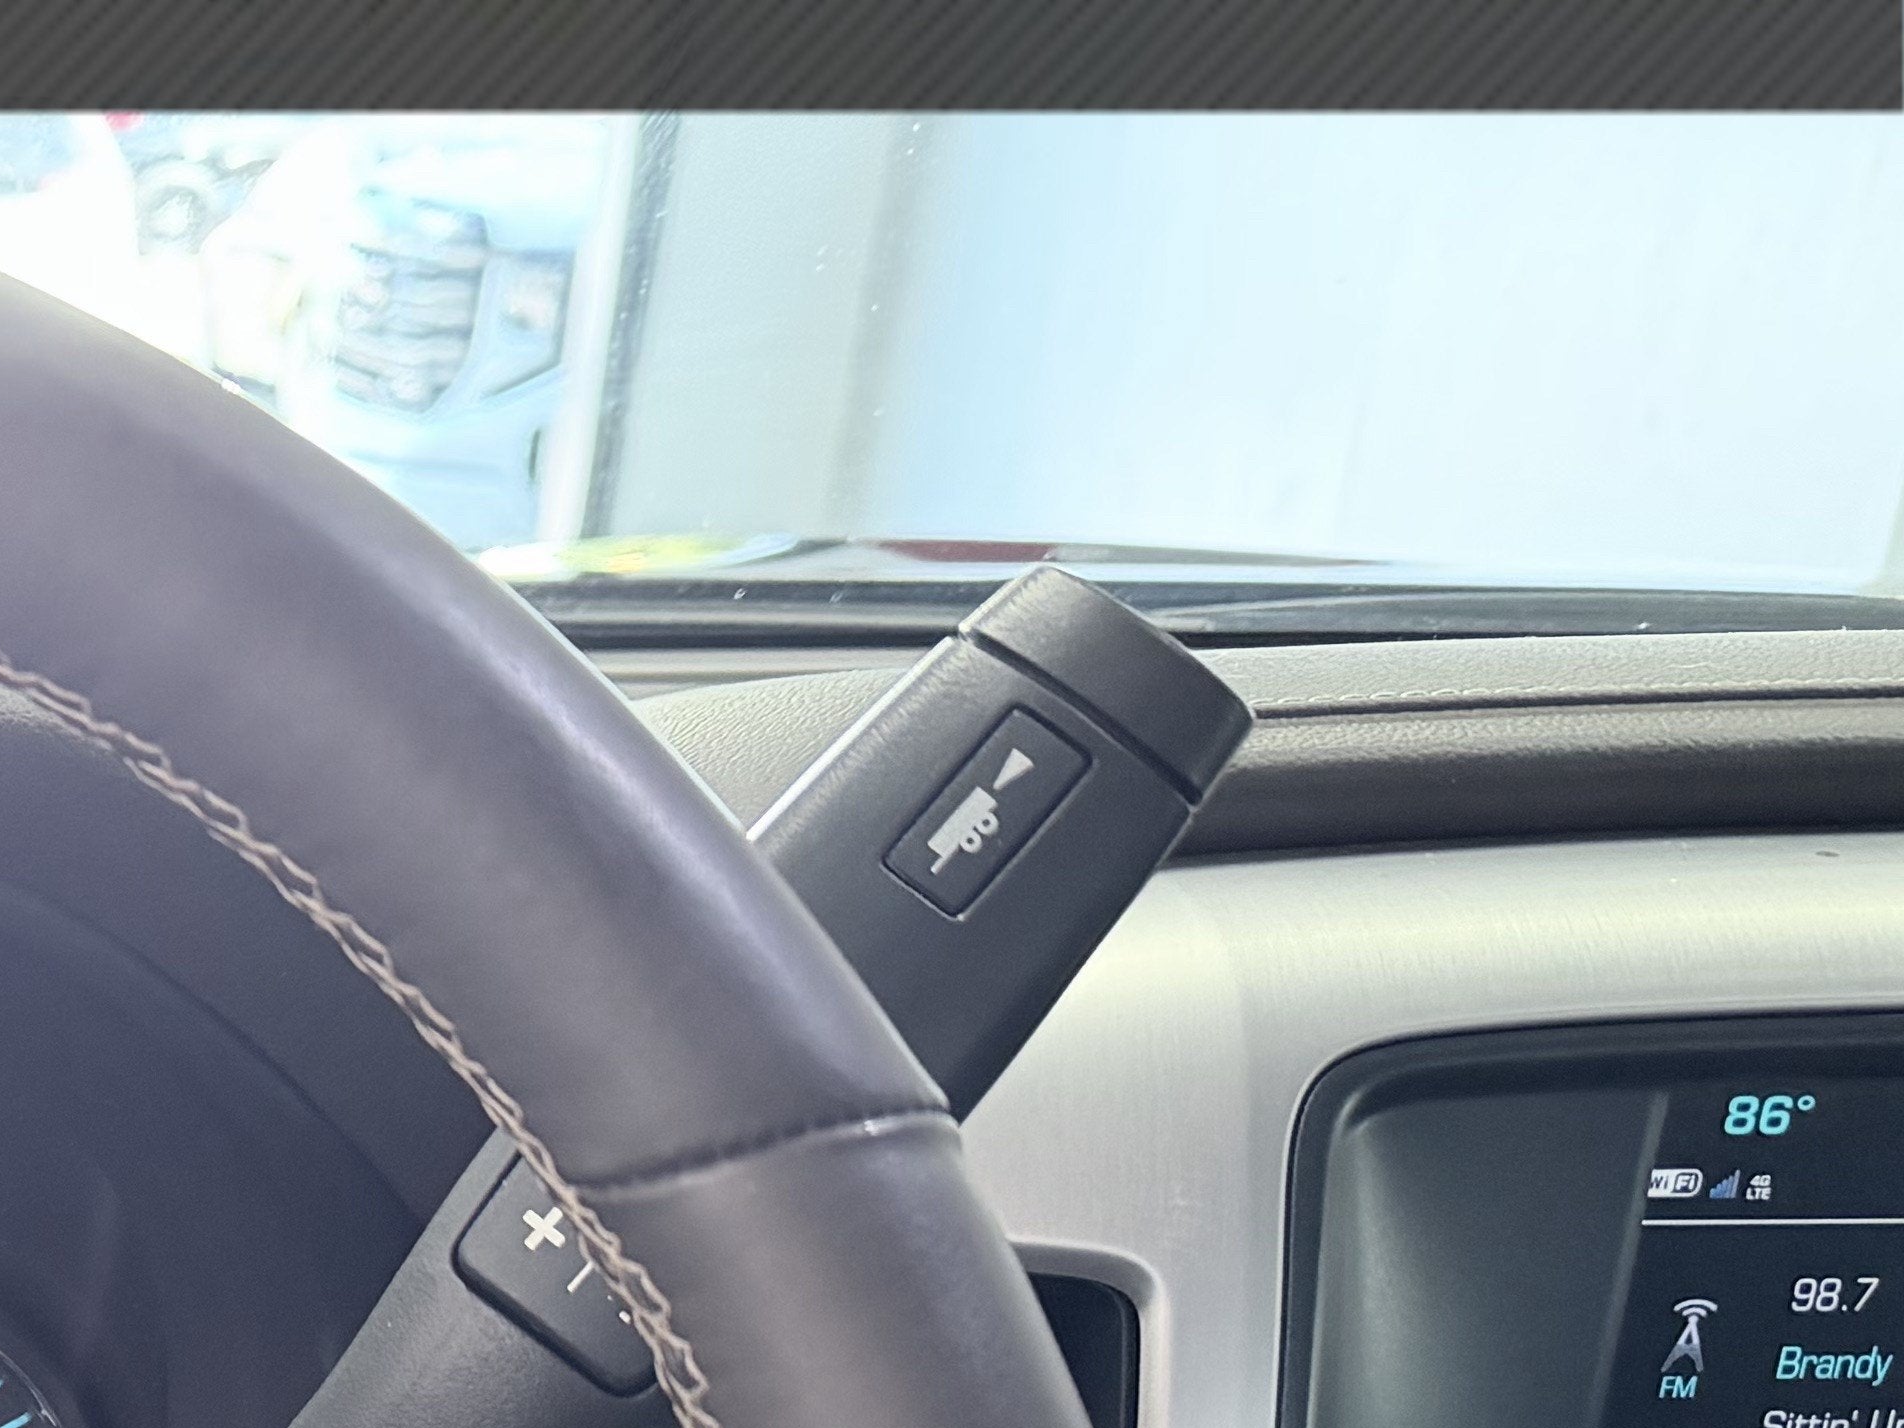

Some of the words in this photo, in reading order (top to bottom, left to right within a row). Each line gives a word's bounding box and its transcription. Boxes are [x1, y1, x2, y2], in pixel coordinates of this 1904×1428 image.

[1723, 1094, 1817, 1136] 86°
[1745, 1187, 1772, 1201] LTE
[1790, 1276, 1881, 1313] 98.7
[1775, 1345, 1894, 1387] Brandy
[1659, 1375, 1698, 1398] FM
